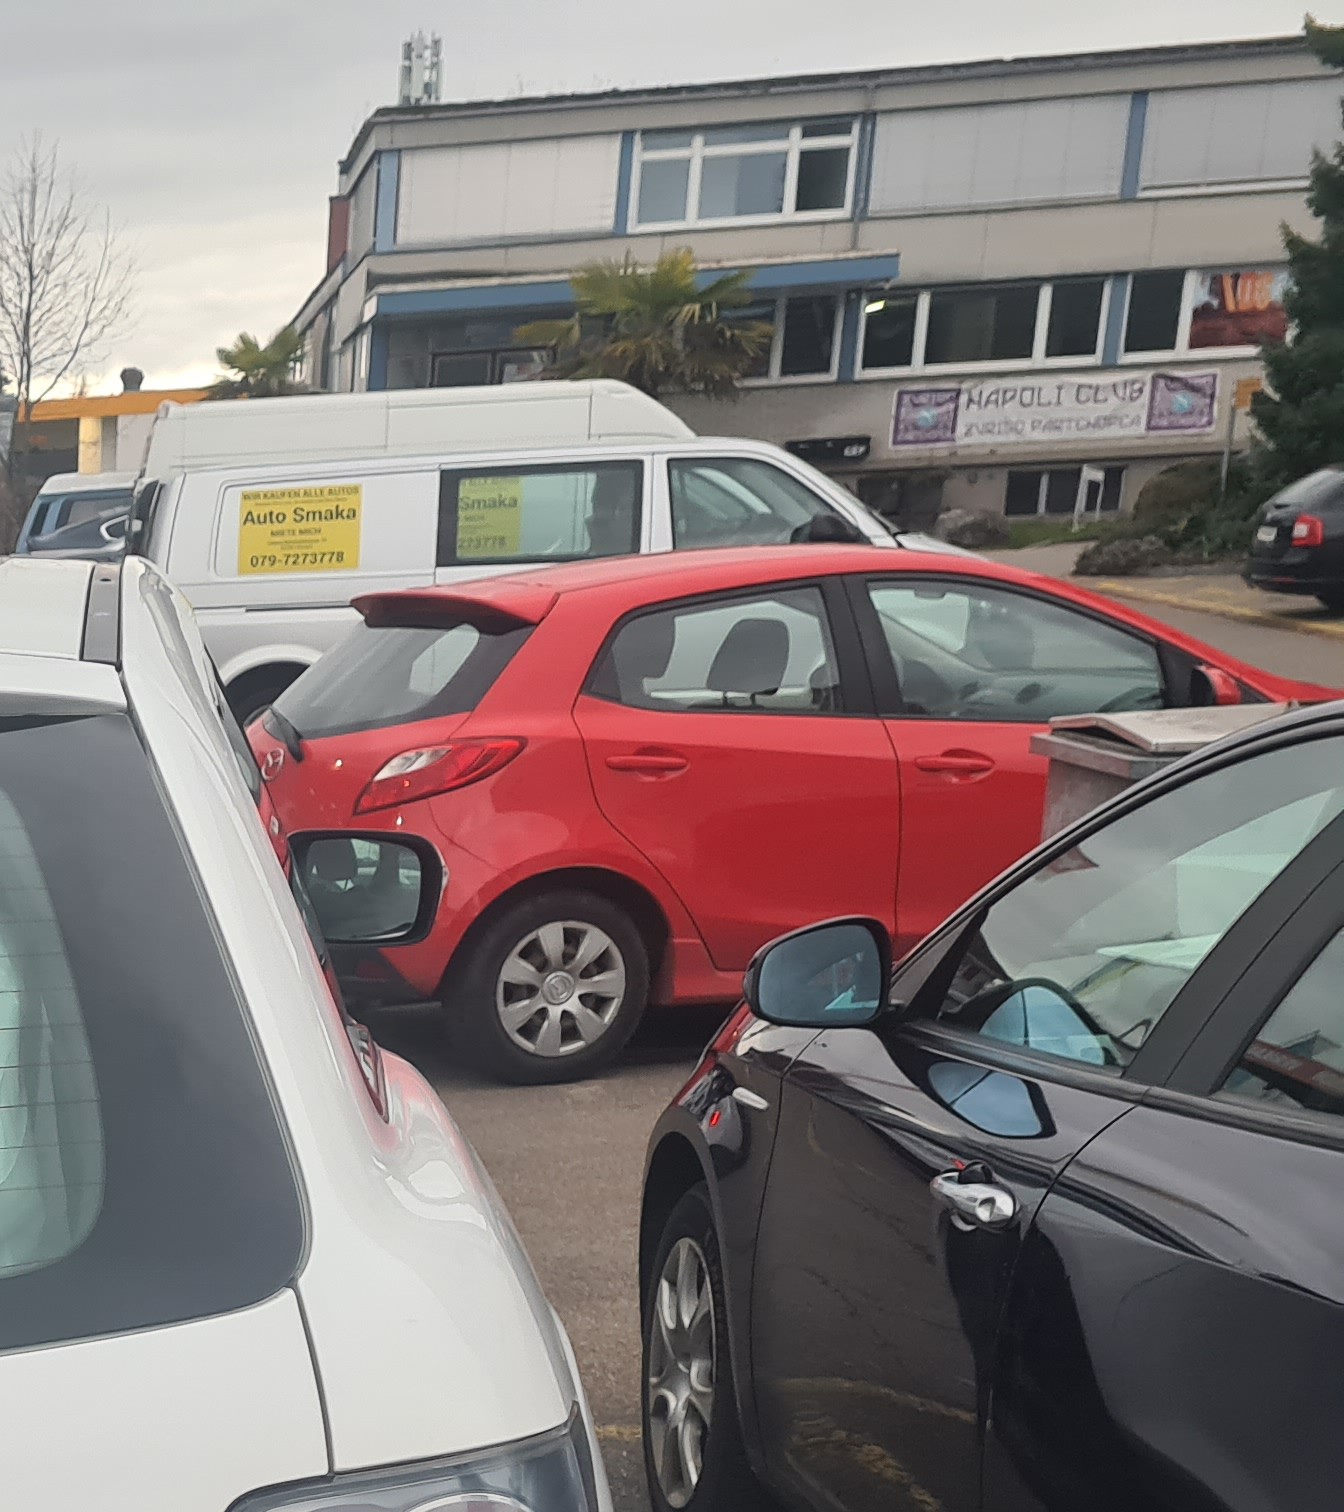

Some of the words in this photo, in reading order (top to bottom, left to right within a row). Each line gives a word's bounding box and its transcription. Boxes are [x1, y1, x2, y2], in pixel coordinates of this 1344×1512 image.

[965, 384, 1064, 411] NAPOLI
[242, 510, 287, 526] Auto
[292, 504, 357, 523] Smaka
[250, 551, 344, 568] 079-7273778
